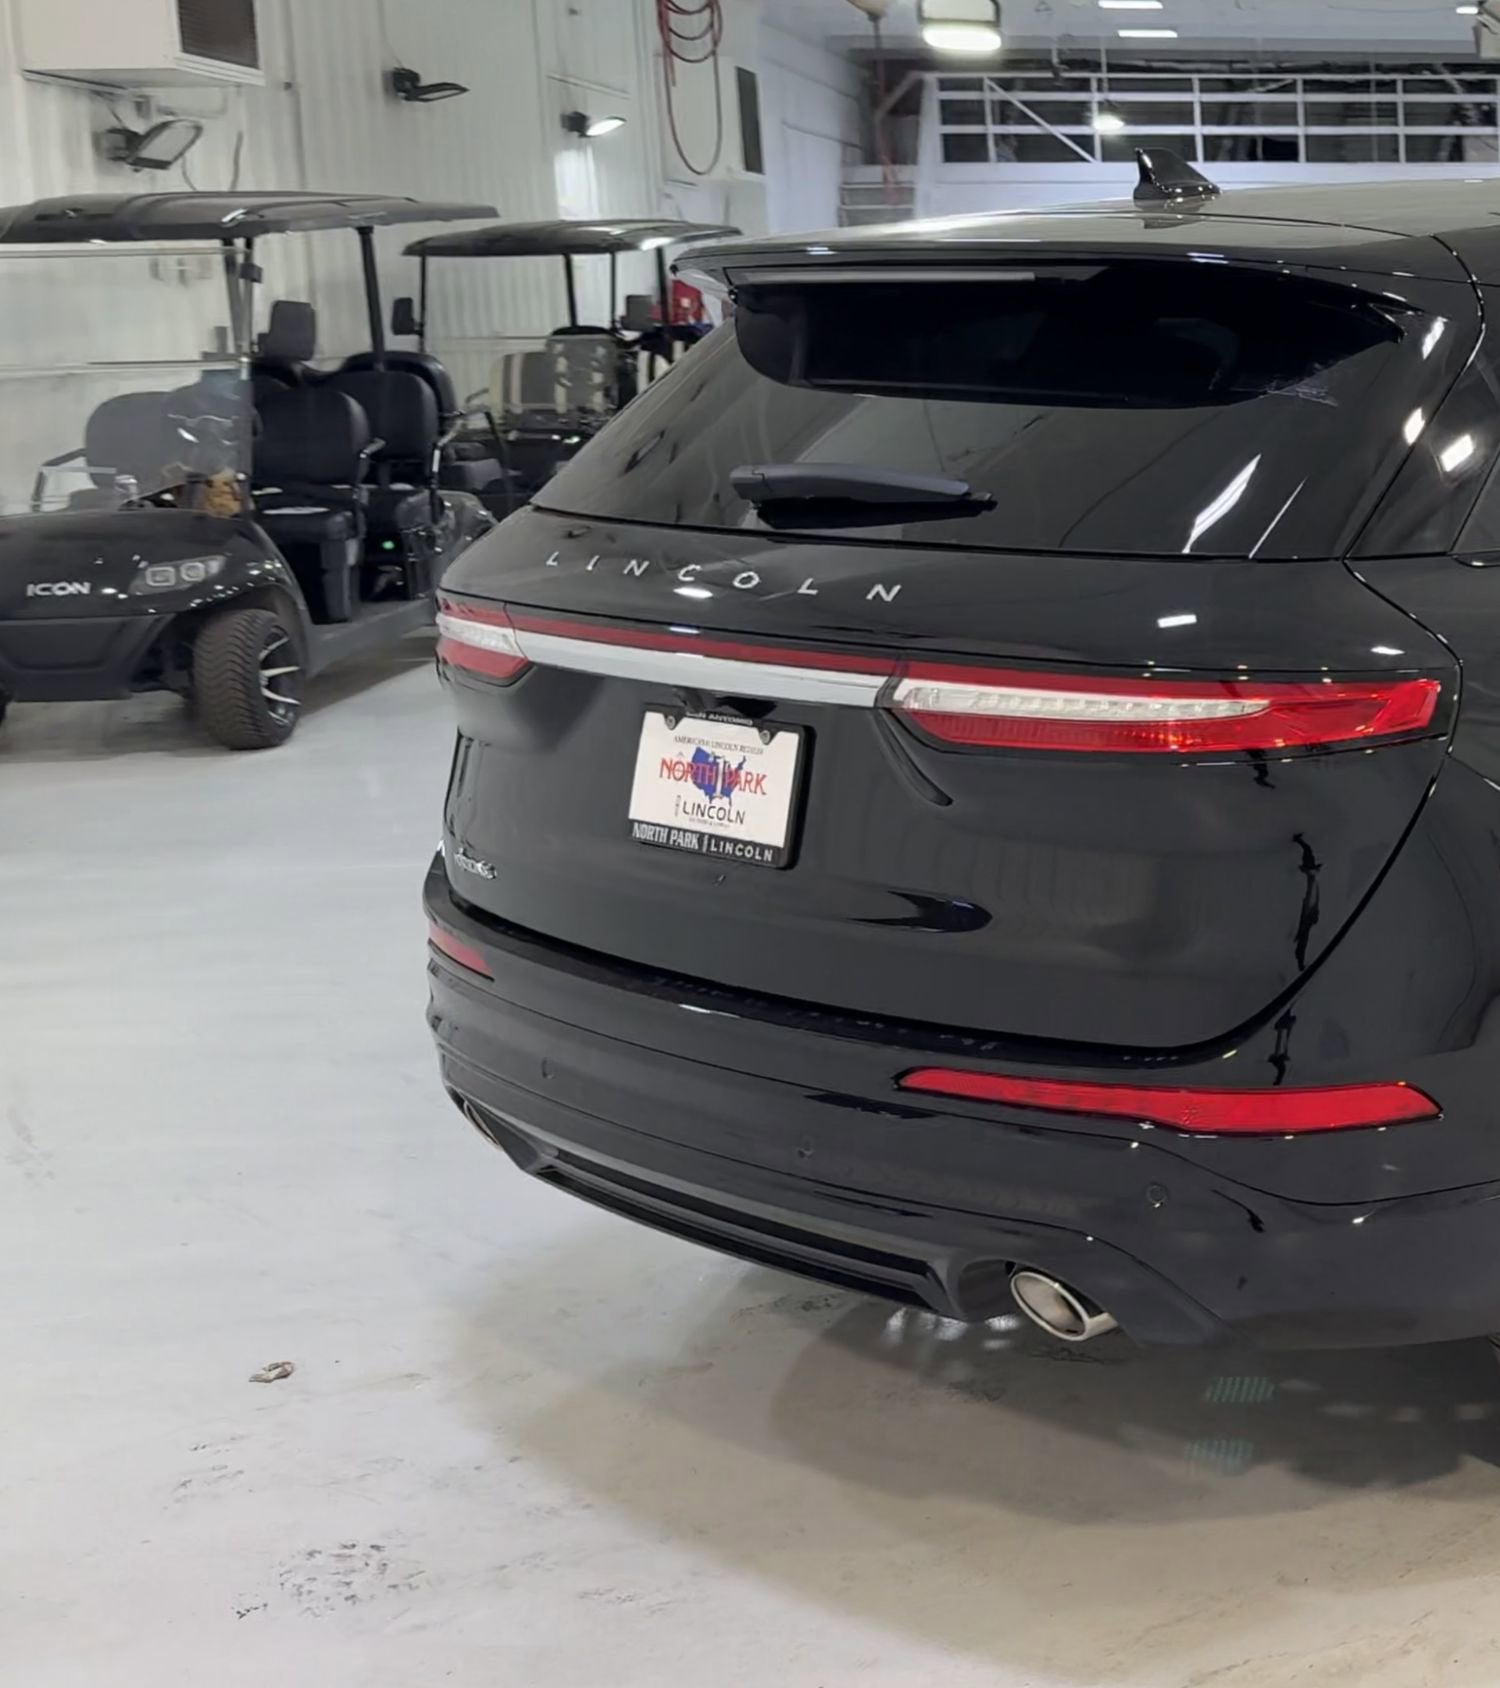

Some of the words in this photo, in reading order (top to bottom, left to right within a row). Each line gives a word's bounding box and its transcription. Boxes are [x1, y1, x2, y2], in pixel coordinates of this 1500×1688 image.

[26, 581, 91, 597] ICON
[546, 551, 901, 602] LINCOLN
[659, 757, 716, 785] NORTH
[725, 766, 768, 795] PARK
[682, 800, 746, 825] LINCOLN
[632, 822, 669, 844] NORTH
[669, 829, 700, 850] PARK
[710, 839, 773, 862] LINCOLN
